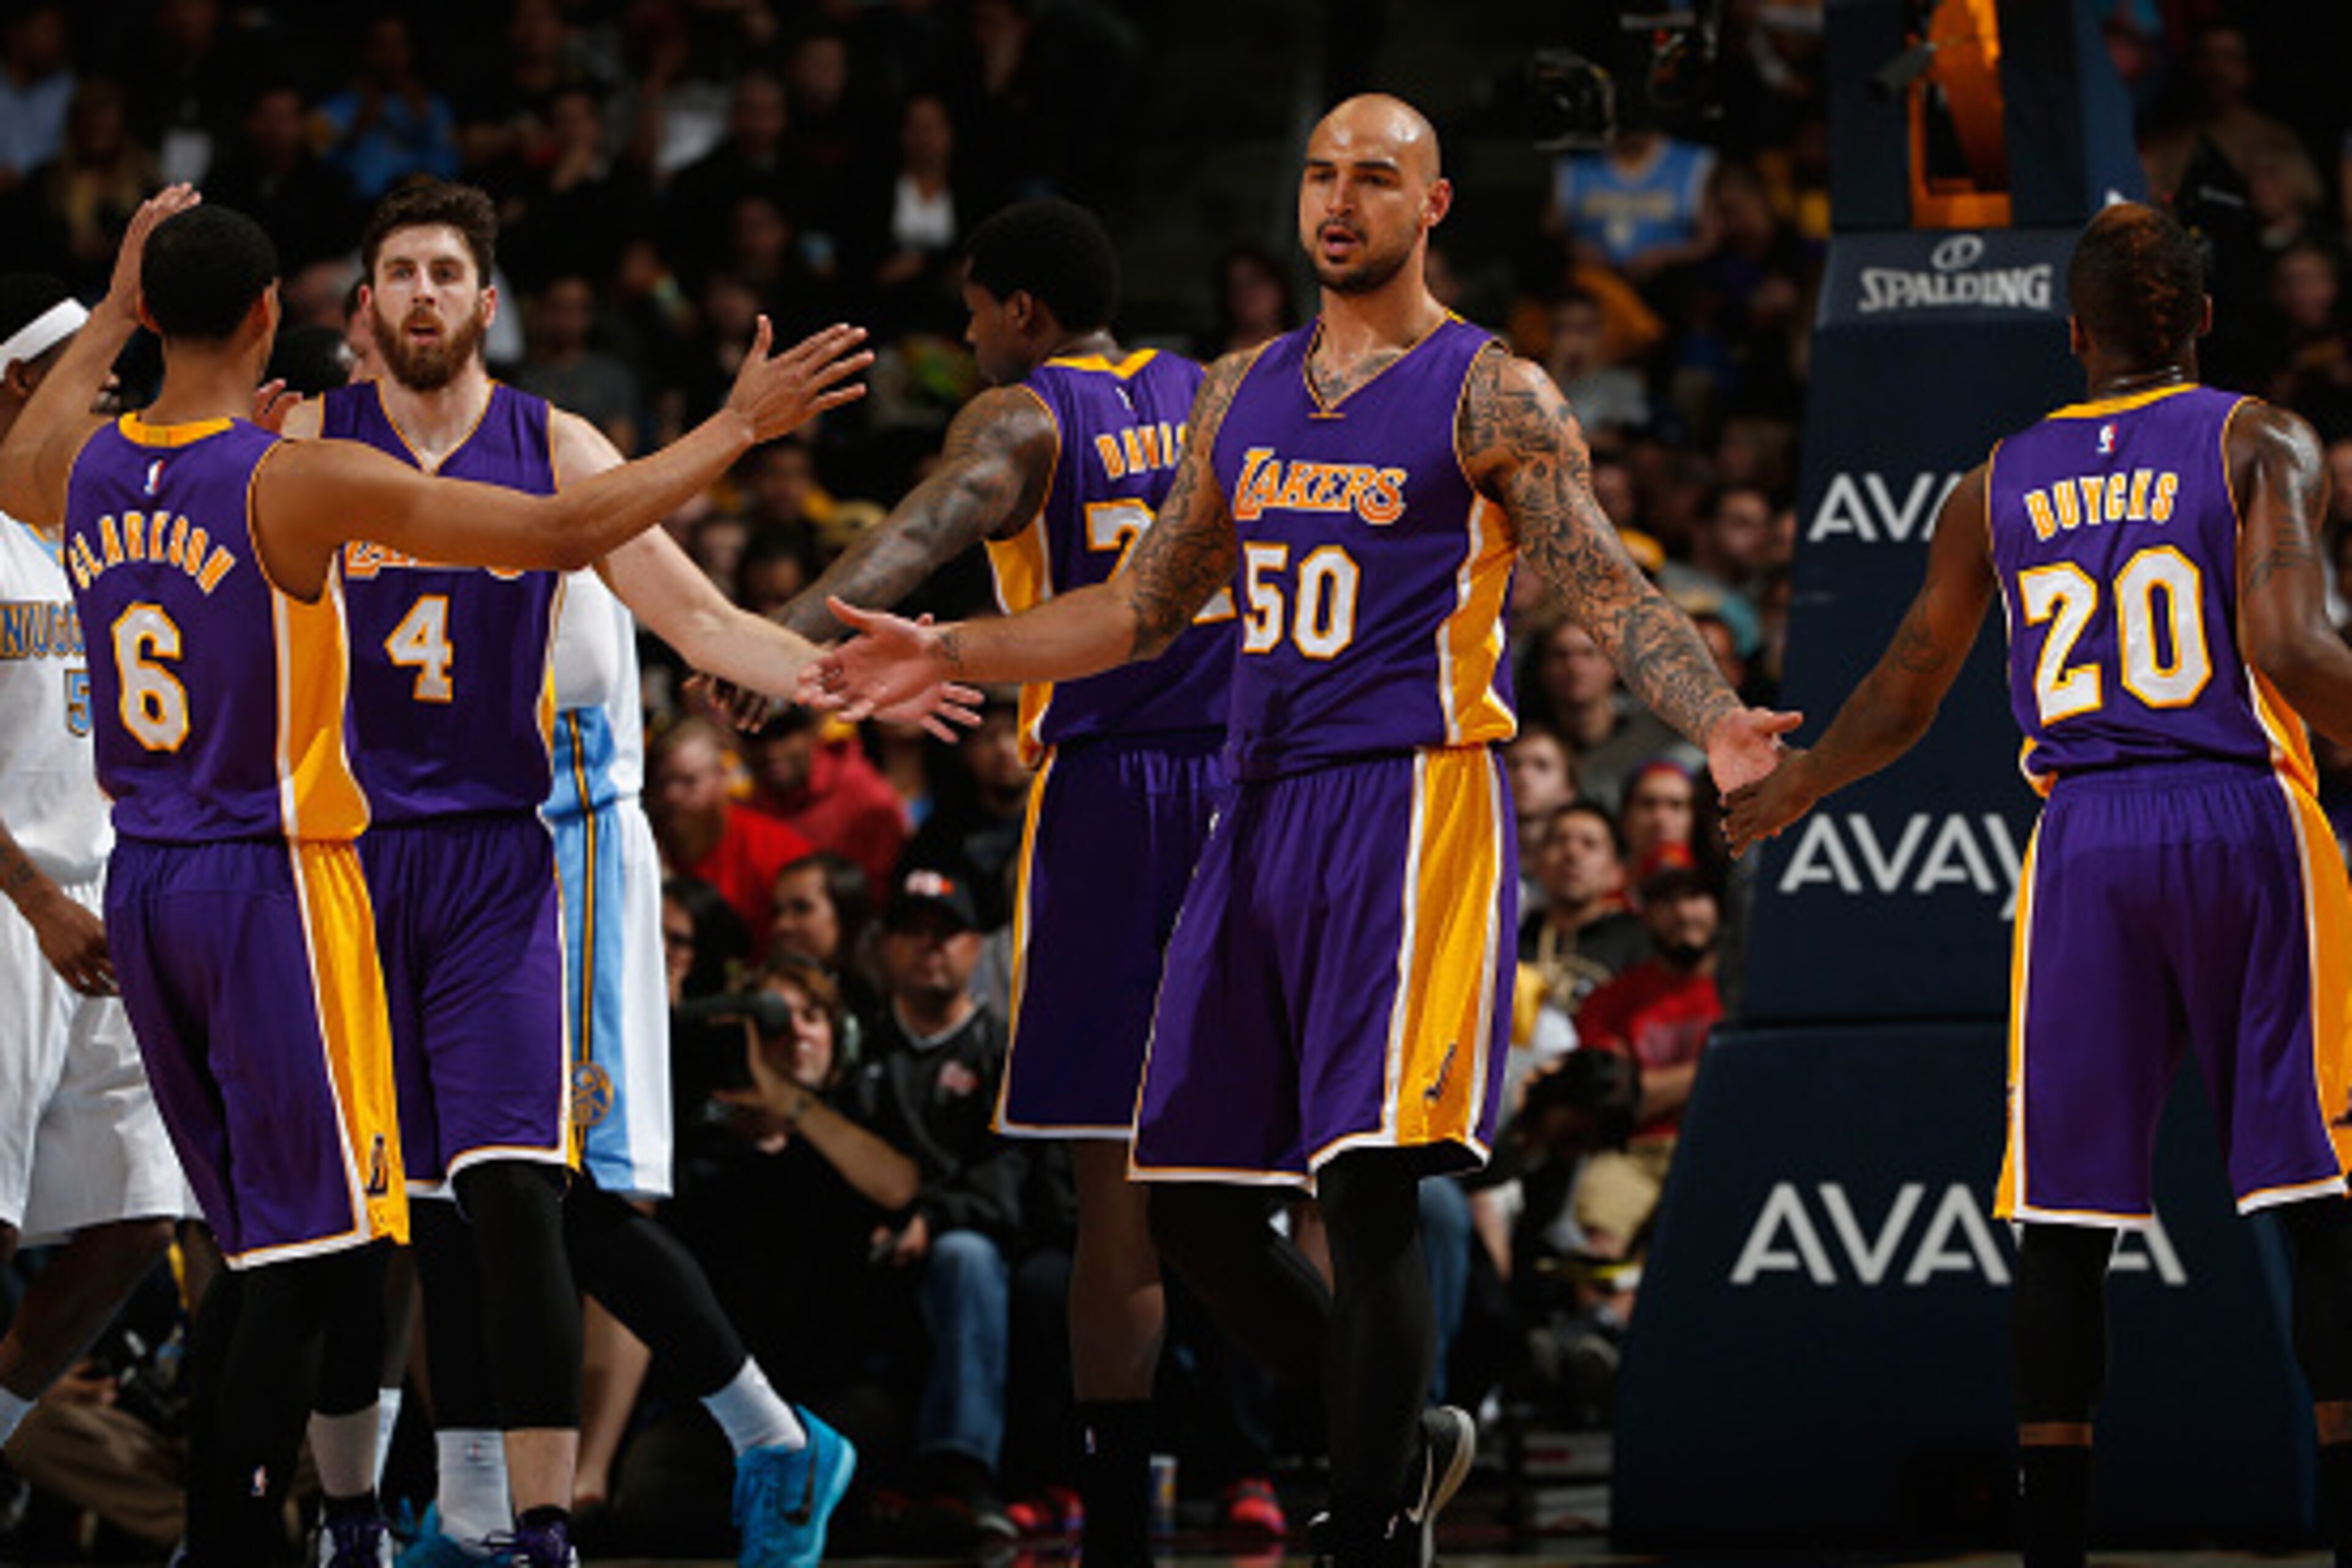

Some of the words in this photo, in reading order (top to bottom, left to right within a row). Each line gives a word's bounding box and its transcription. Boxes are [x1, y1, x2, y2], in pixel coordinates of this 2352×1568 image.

[1859, 265, 2052, 312] SPALDING
[1233, 447, 1408, 526] LAKERS
[2024, 469, 2178, 540] BUYCKS
[384, 594, 453, 703] 4
[1242, 541, 1360, 660] 50
[2018, 544, 2212, 727] 20
[111, 601, 189, 752] 6
